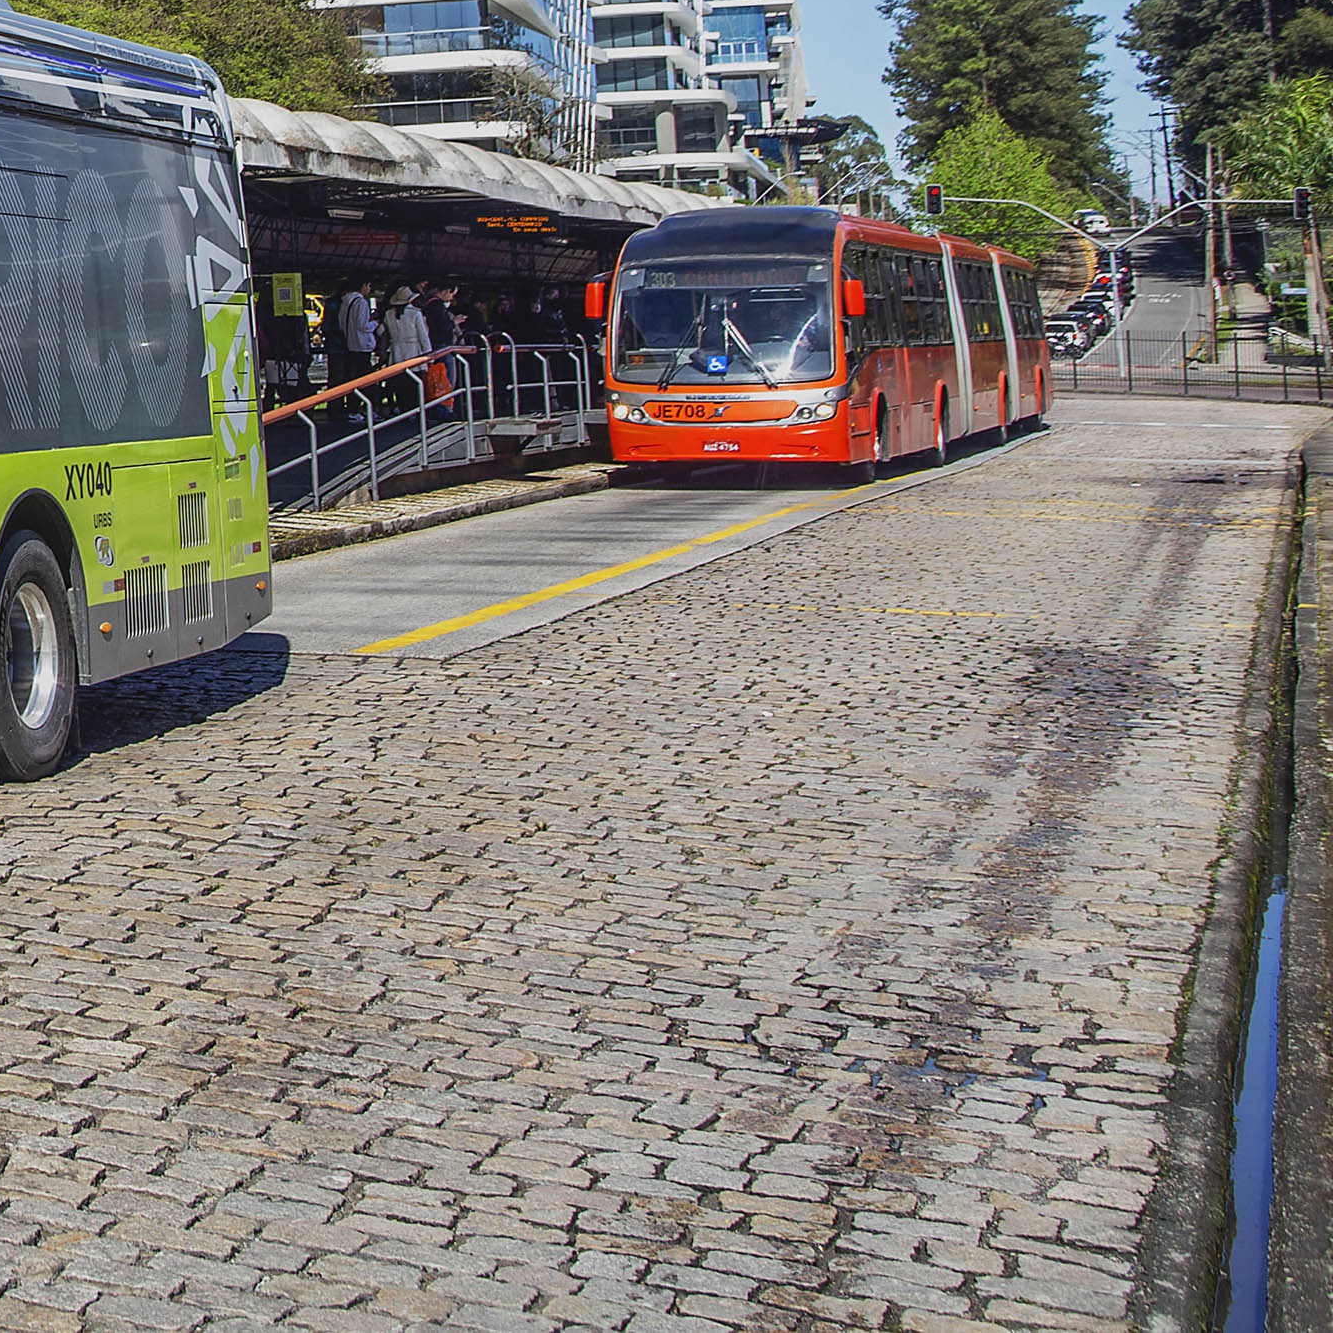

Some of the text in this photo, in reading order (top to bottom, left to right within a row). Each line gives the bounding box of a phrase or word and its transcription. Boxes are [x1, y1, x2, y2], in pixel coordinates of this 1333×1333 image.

[651, 272, 676, 287] 303
[653, 404, 705, 419] JE708
[64, 461, 112, 501] XY040
[93, 512, 112, 529] URBS
